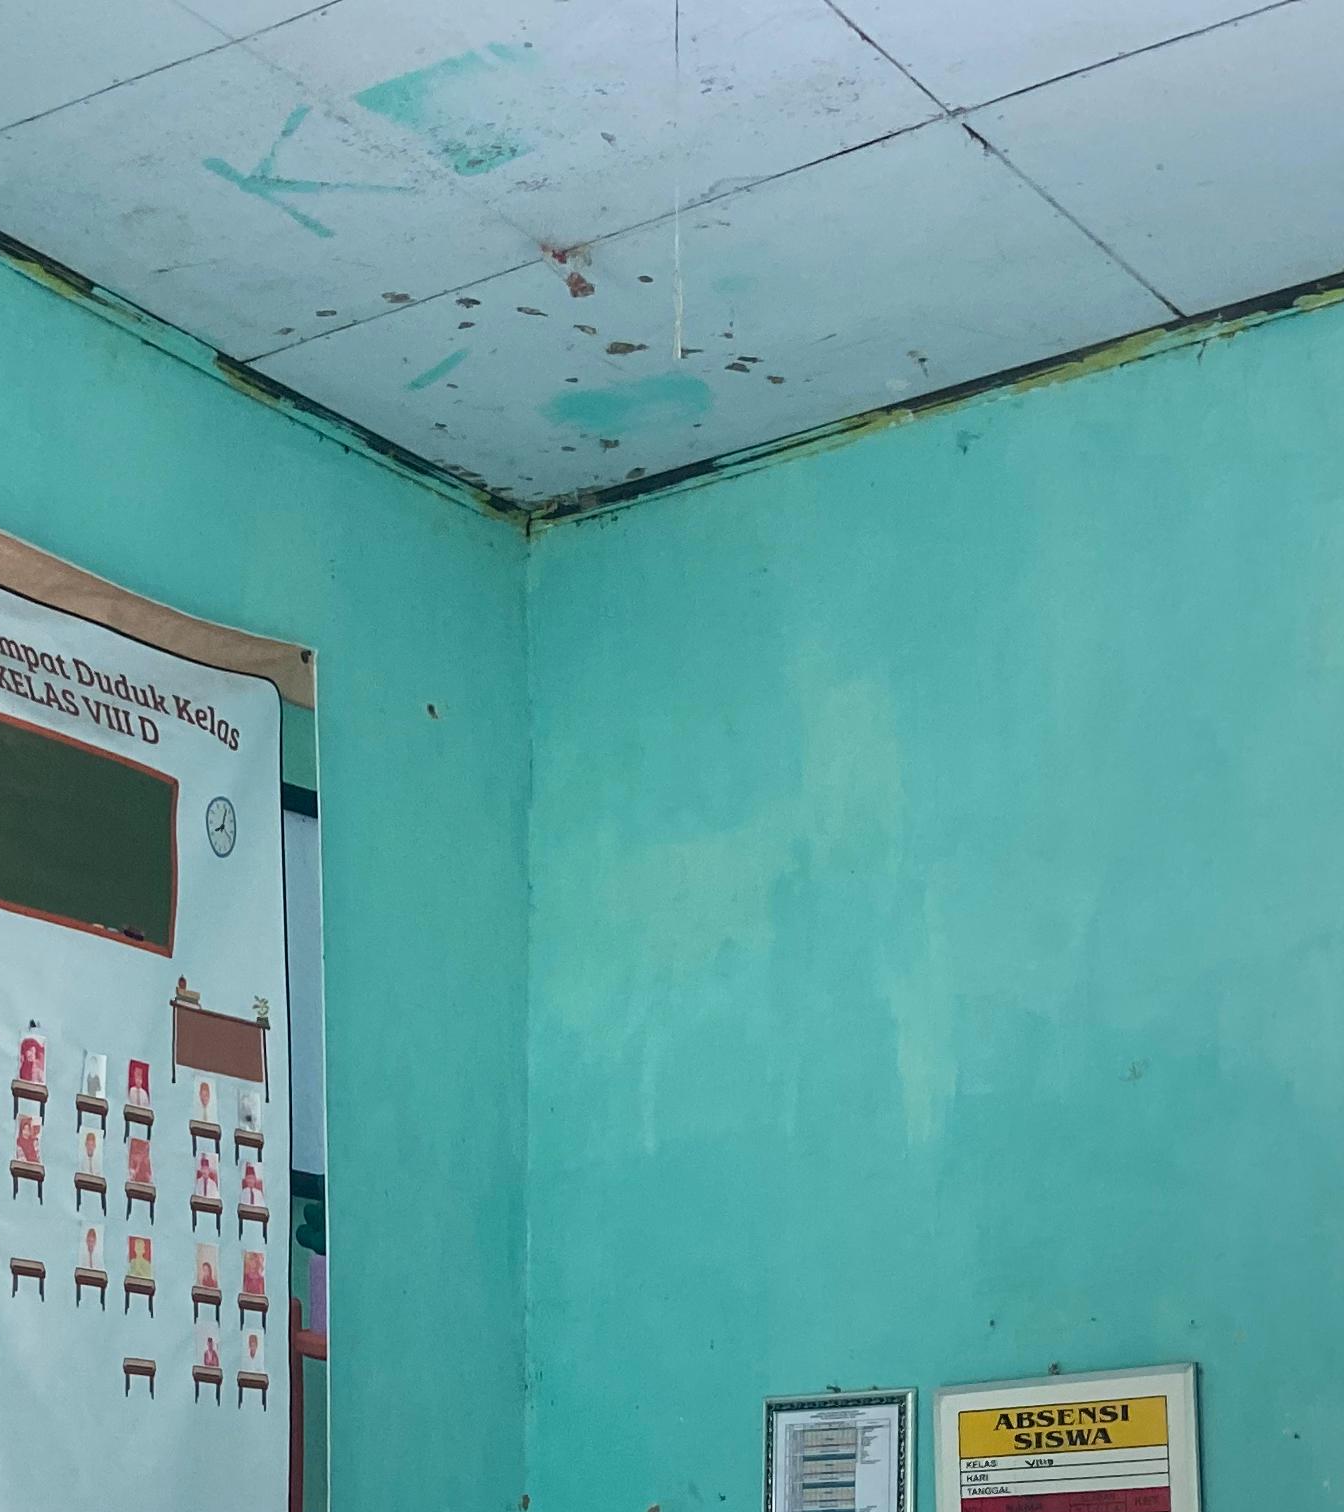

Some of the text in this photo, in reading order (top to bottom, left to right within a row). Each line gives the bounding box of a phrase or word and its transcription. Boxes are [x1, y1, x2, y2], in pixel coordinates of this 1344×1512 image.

[72, 658, 170, 715] Duduk
[173, 693, 241, 752] Kelas
[82, 695, 135, 737] VIII
[141, 717, 160, 745] D
[993, 1404, 1130, 1432] ABSENSI
[1013, 1428, 1113, 1451] SISWA
[965, 1459, 997, 1469] KELAS
[967, 1486, 1011, 1496] TANGGAL
